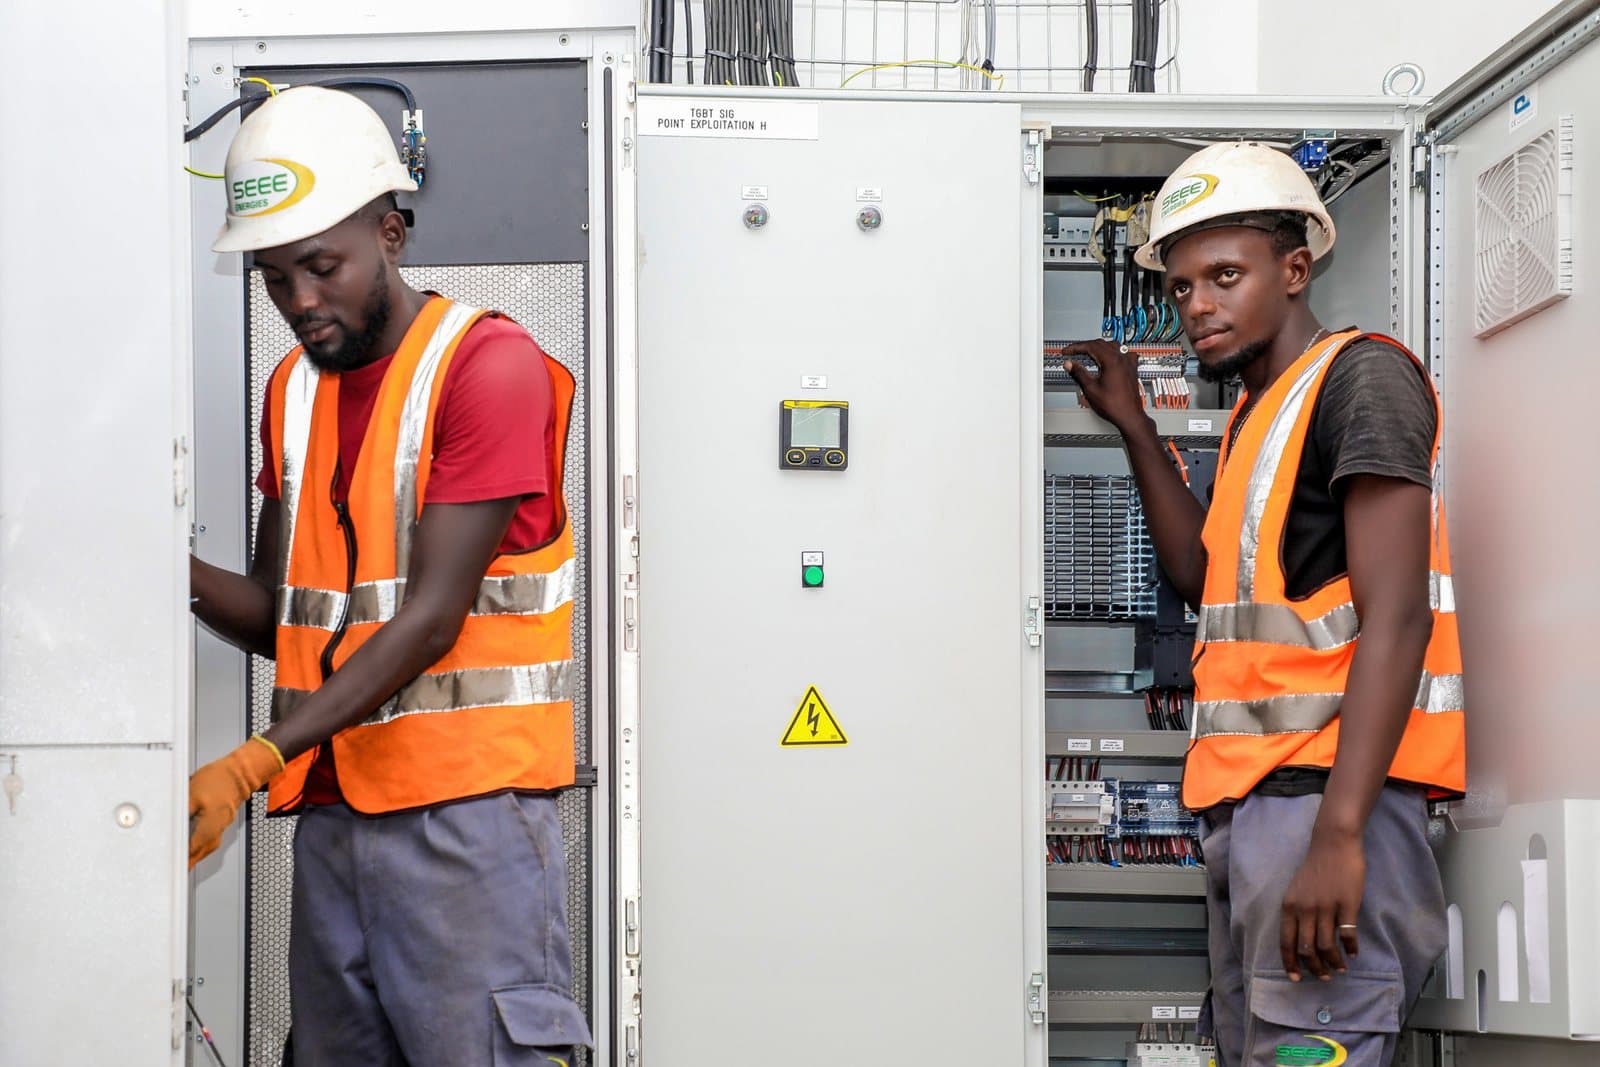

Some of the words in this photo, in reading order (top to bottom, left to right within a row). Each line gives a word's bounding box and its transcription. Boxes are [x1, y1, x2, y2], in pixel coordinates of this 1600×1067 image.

[690, 108, 714, 119] TGBT
[719, 109, 735, 119] SIG
[657, 118, 685, 129] POINT
[690, 119, 755, 131] EXPLOITATION
[760, 121, 767, 131] H
[232, 173, 288, 201] SEEE
[1160, 181, 1203, 211] SEEE
[1275, 1046, 1331, 1060] SEEE
